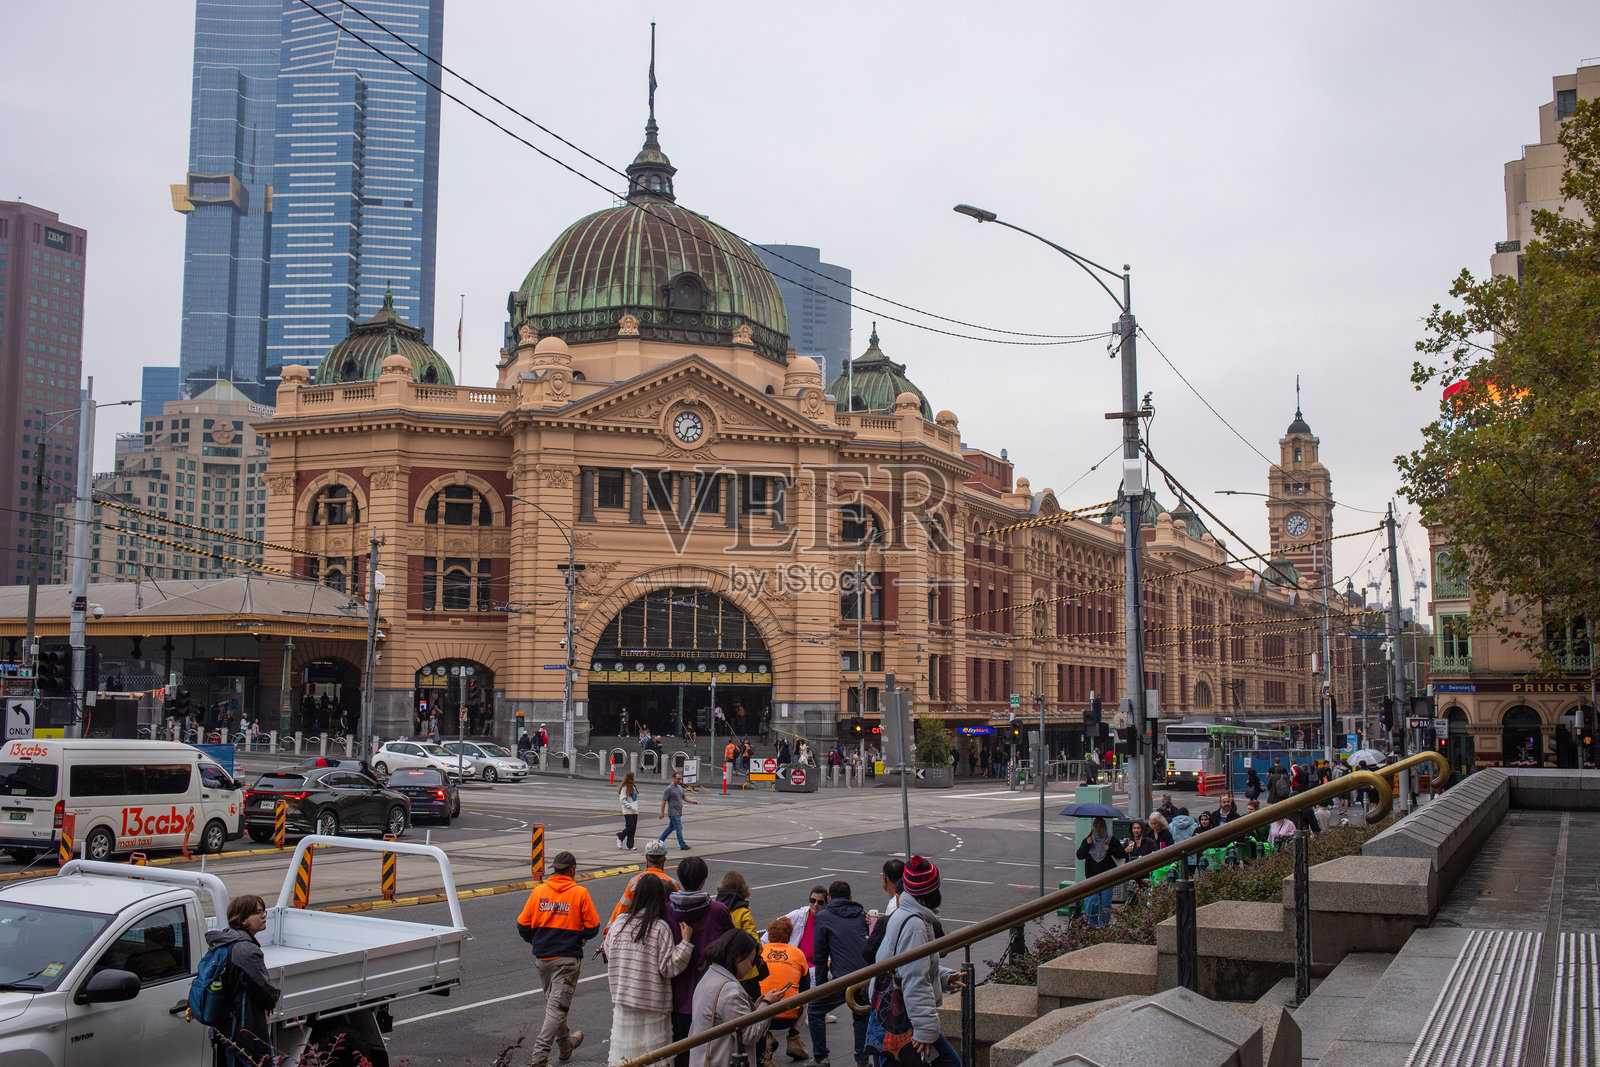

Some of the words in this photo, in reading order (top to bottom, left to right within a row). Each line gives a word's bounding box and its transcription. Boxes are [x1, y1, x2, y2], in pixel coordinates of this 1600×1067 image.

[48, 231, 64, 244] IBM
[248, 402, 275, 417] Langha
[620, 649, 661, 658] FLINDERS
[670, 650, 702, 659] STREET
[710, 651, 746, 660] STATION
[1512, 683, 1592, 692] PRINCE'S
[9, 727, 30, 736] ONLY
[9, 743, 48, 757] 13cabs
[121, 806, 195, 837] 13cabs
[117, 838, 137, 848] maxi
[137, 836, 153, 846] taxi
[70, 1032, 95, 1043] TRITON
